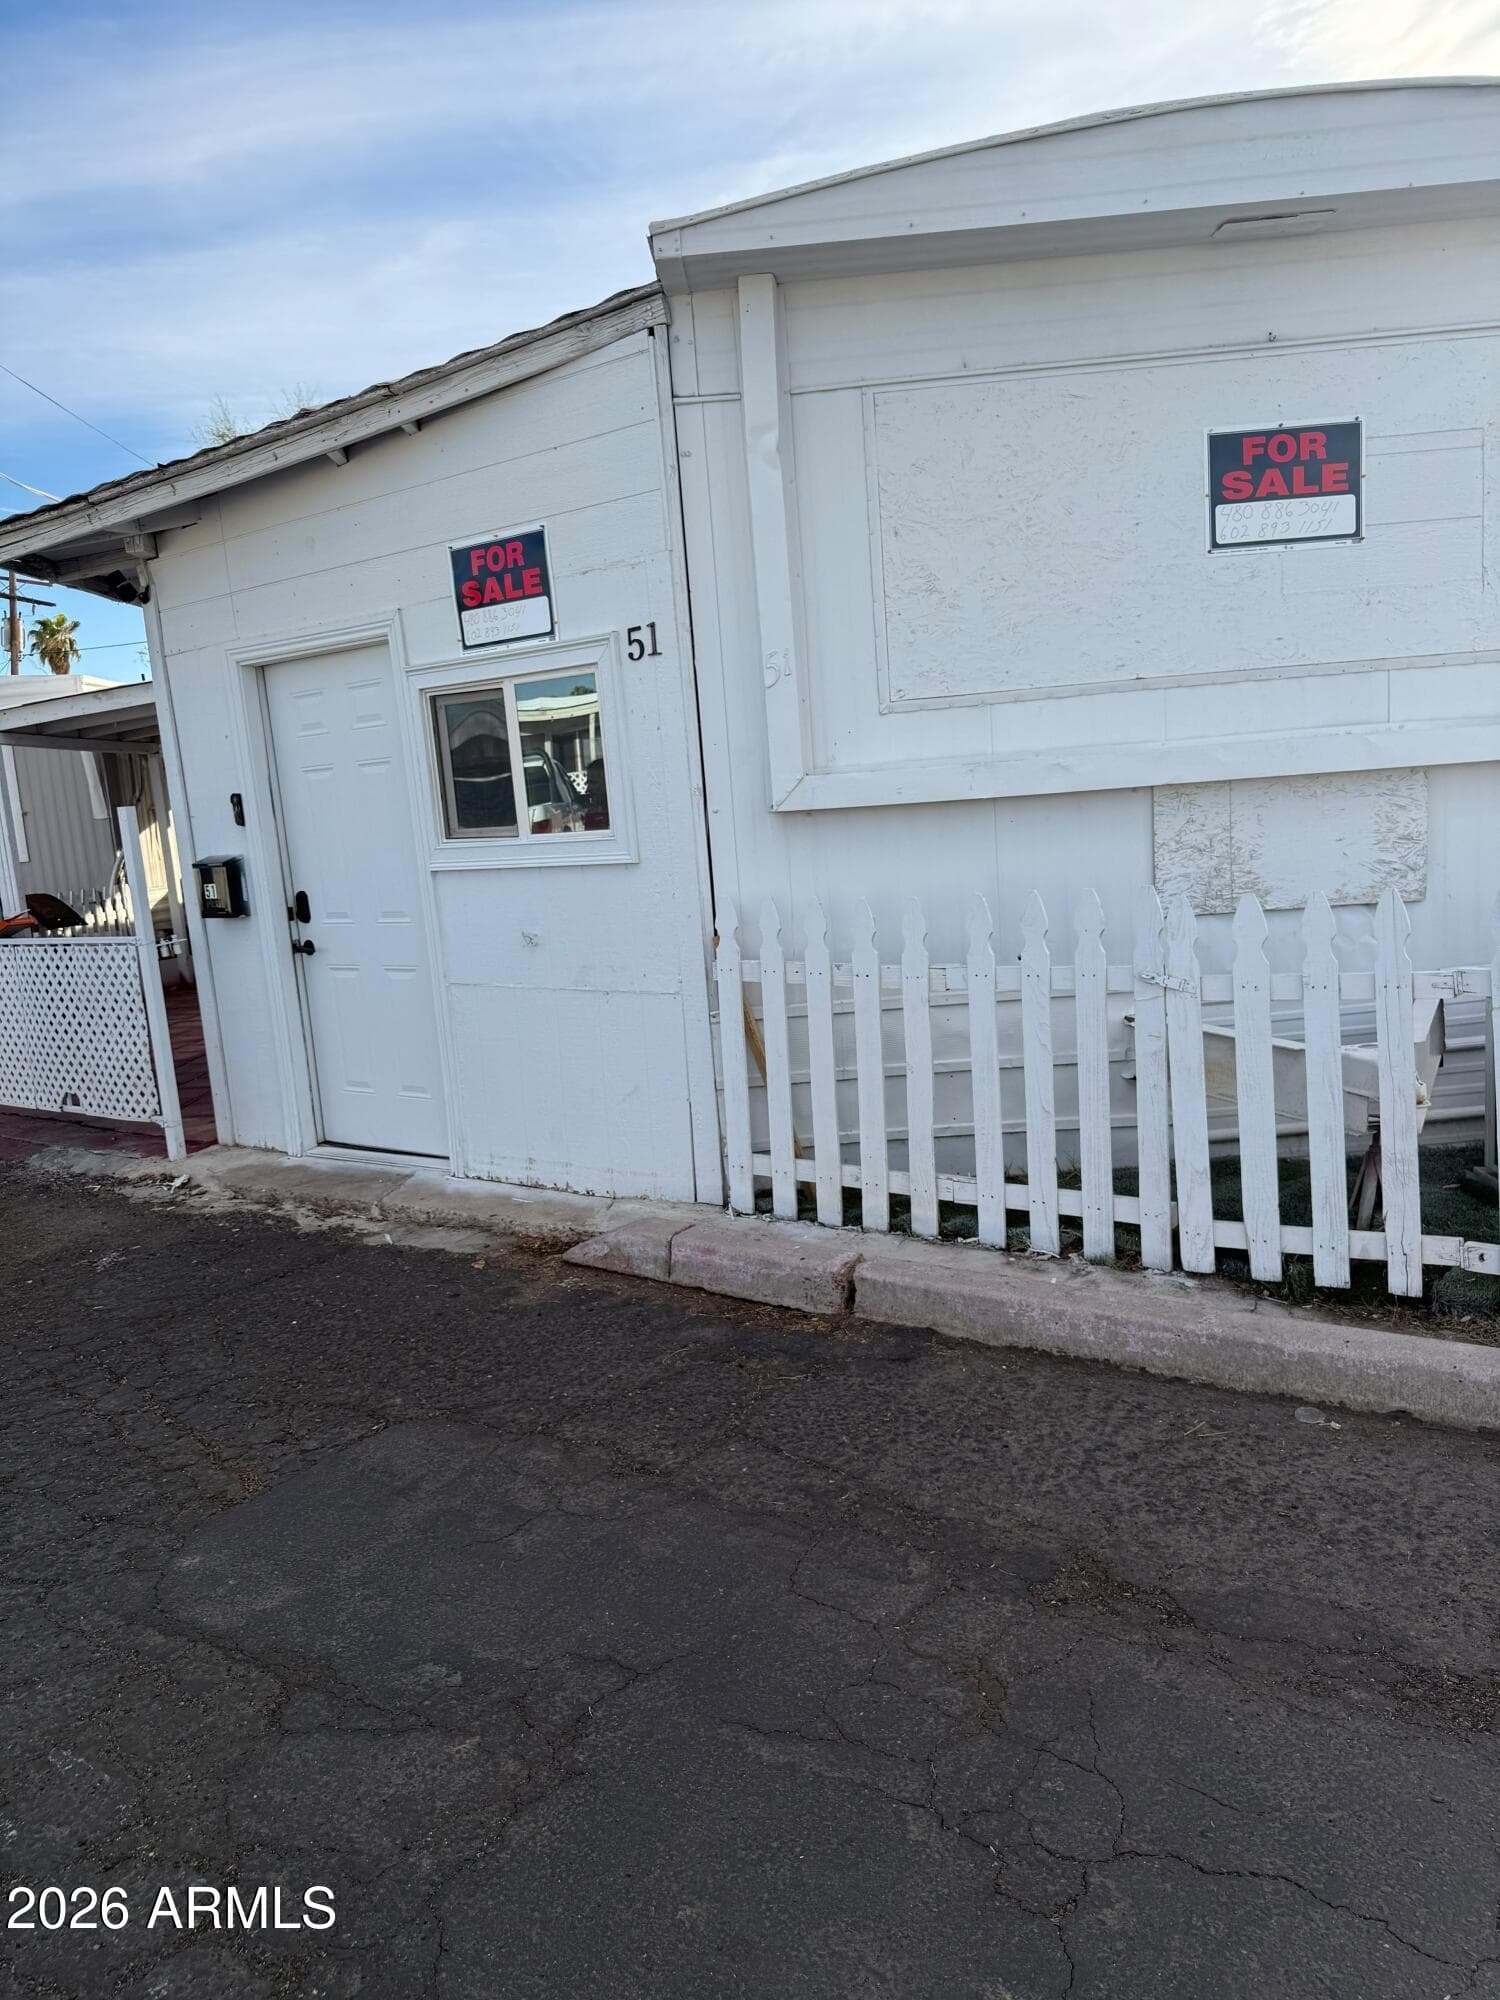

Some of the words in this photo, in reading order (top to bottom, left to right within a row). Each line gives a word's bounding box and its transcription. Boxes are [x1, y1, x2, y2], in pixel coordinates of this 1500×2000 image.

[1242, 431, 1328, 466] FOR
[1221, 462, 1349, 500] SALE
[1220, 505, 1253, 522] 480
[1261, 502, 1294, 520] 886
[1219, 525, 1250, 540] 602
[1258, 521, 1290, 538] 893
[470, 541, 525, 577] FOR
[462, 567, 543, 607] SALE
[627, 621, 663, 661] 51
[205, 885, 216, 898] 51
